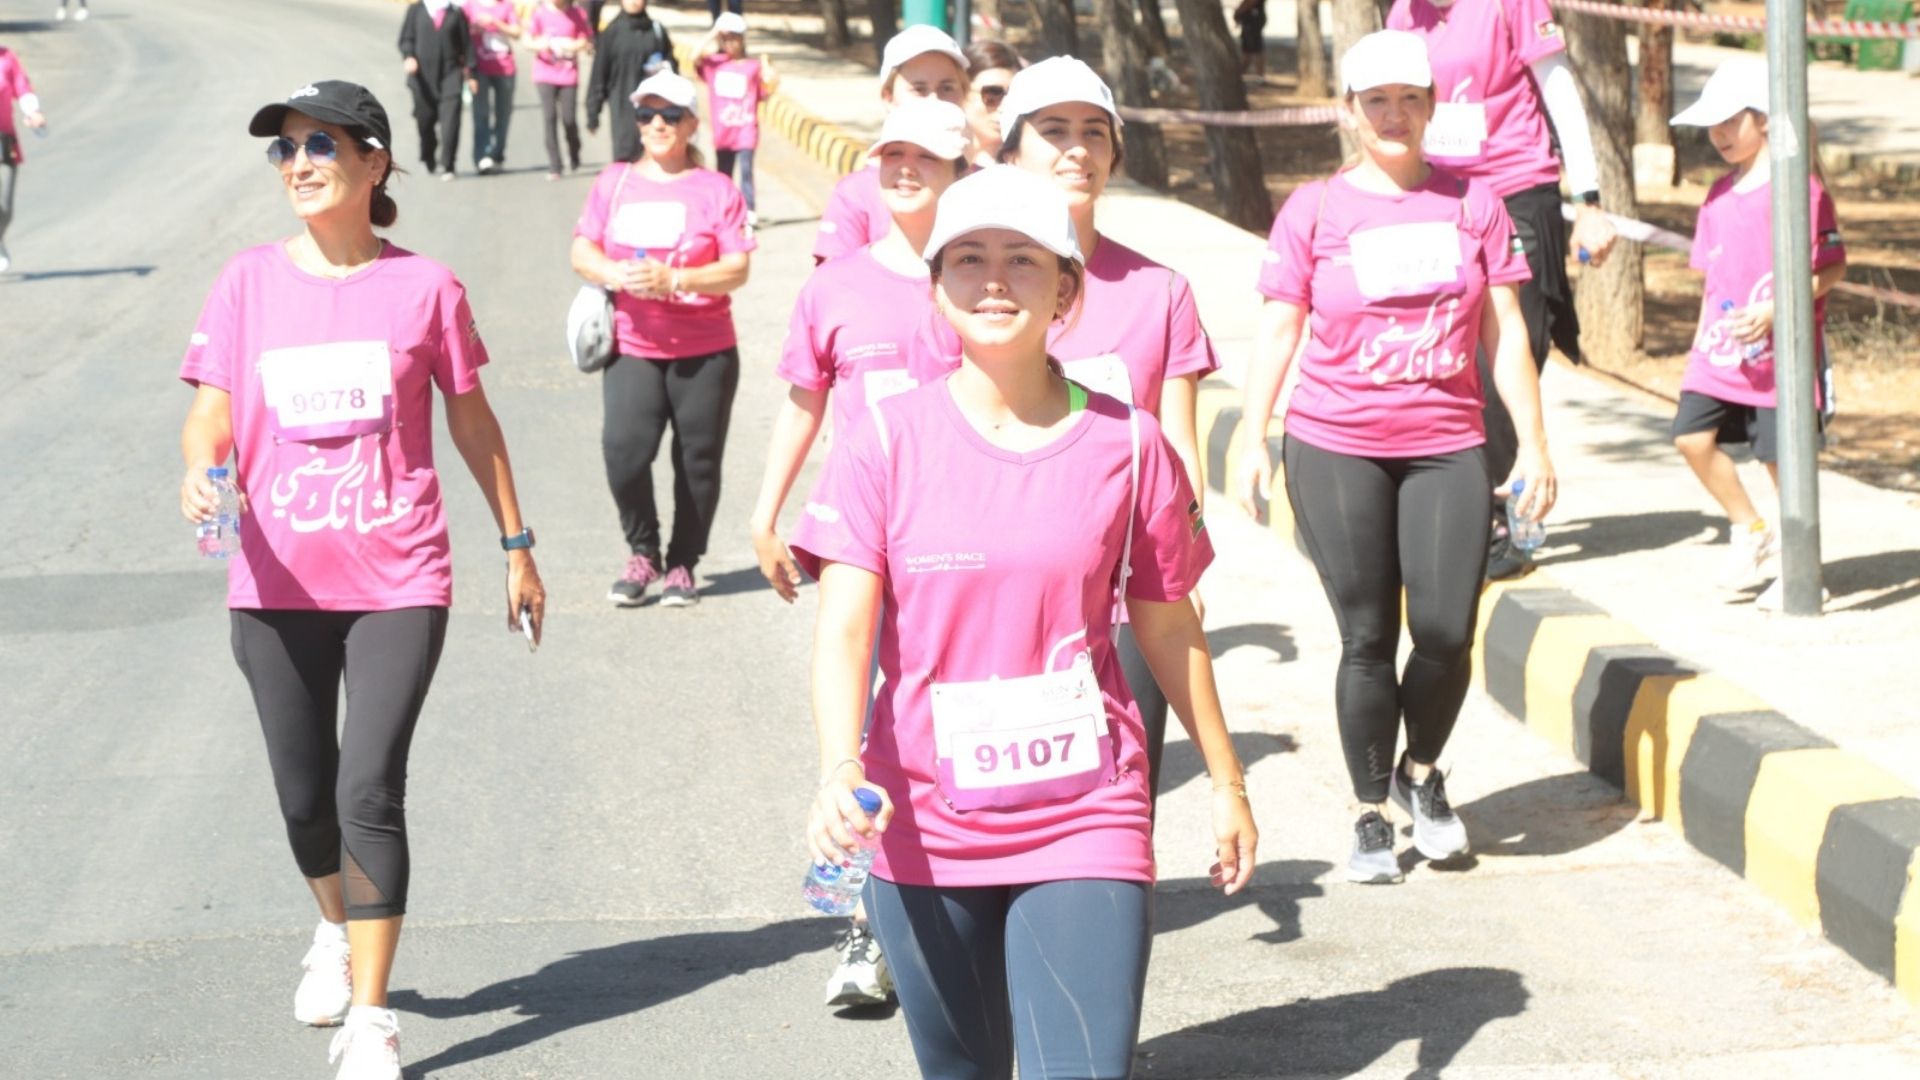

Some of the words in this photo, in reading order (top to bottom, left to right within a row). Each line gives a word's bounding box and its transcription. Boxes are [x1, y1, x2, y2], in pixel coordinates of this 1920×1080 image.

[292, 388, 367, 415] 9078
[905, 553, 953, 565] WOMEN'S
[955, 552, 986, 562] RACE
[974, 731, 1076, 774] 9107
